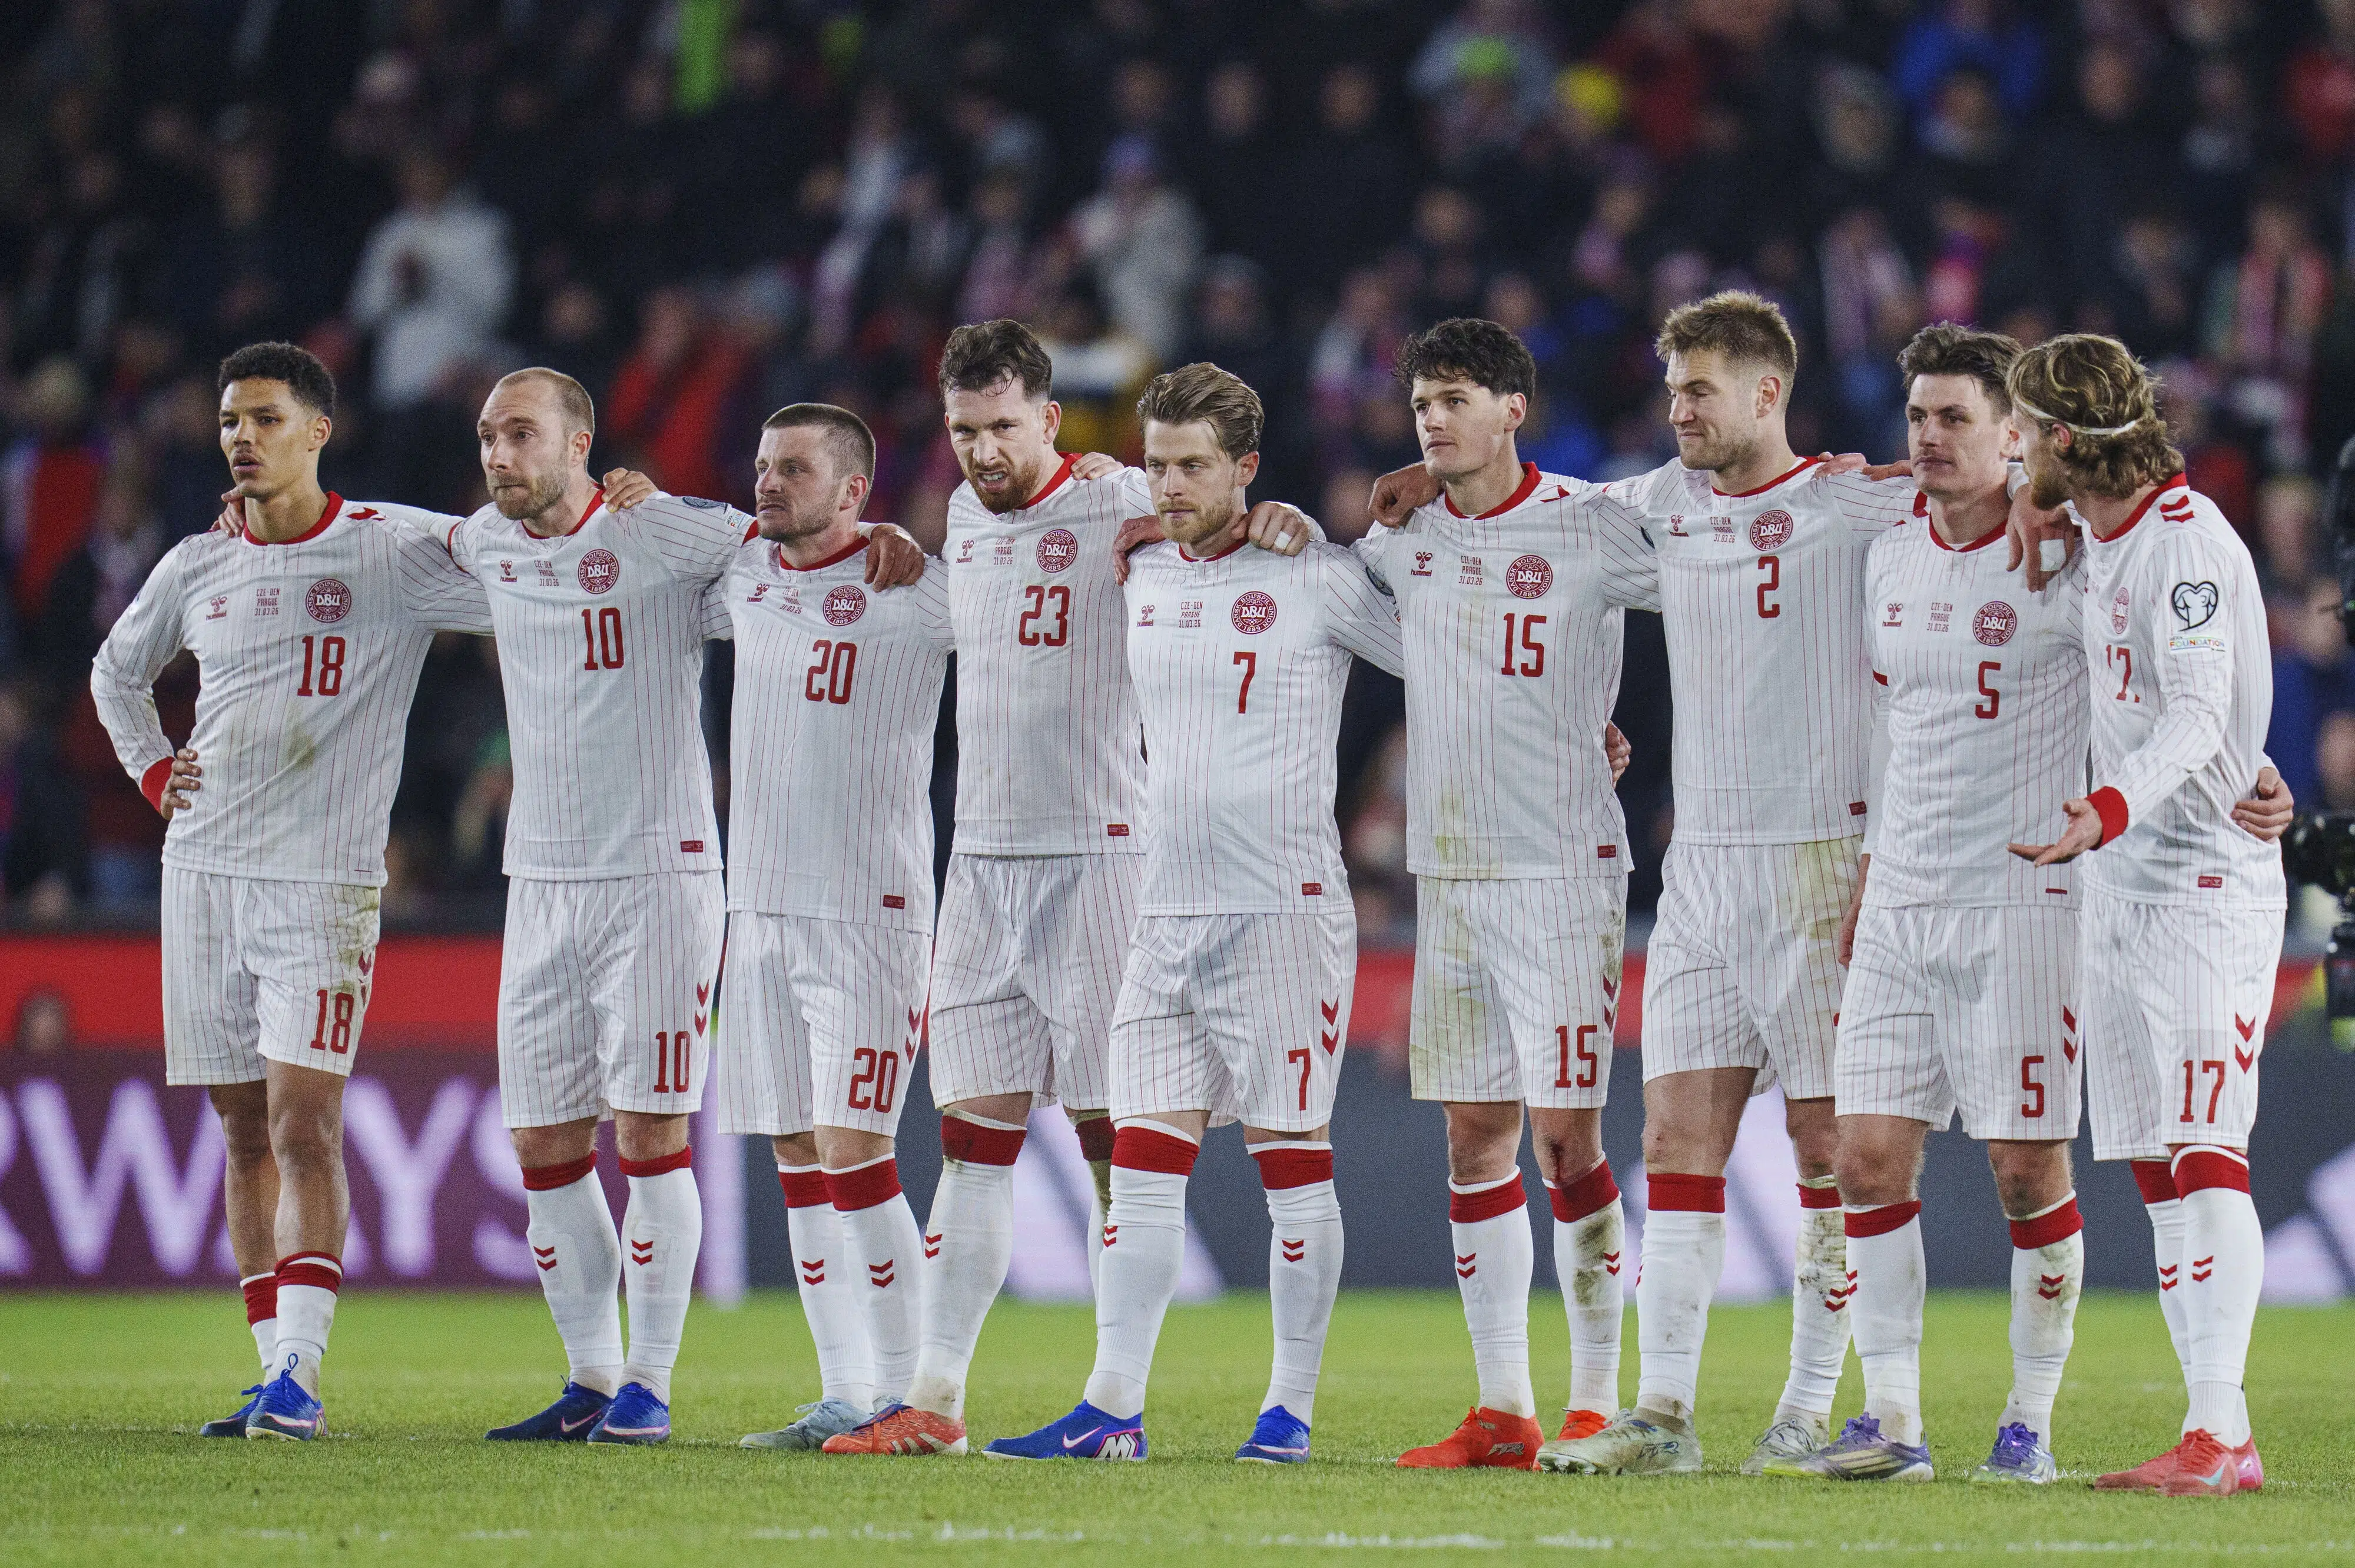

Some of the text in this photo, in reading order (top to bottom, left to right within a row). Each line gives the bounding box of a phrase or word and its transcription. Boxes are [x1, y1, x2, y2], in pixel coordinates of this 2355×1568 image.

[1044, 544, 1068, 556] DBU
[1759, 523, 1783, 536] DBU
[316, 594, 340, 606] DBU
[587, 564, 609, 578] DBU
[1411, 569, 1432, 577] hummel
[1458, 576, 1483, 586] 31.03.26
[1462, 566, 1482, 576] PRAGUE
[1515, 570, 1543, 583] DBU
[1757, 556, 1780, 619] 2
[832, 599, 857, 611] DBU
[1019, 585, 1070, 646] 23
[1178, 619, 1201, 628] 31.03.26
[1240, 606, 1266, 618] DBU
[1982, 616, 2007, 630] DBU
[297, 636, 346, 697] 18
[581, 607, 624, 670] 10
[1501, 613, 1547, 677] 15
[805, 639, 857, 705] 20
[1233, 651, 1256, 714] 7
[1975, 660, 2001, 719] 5
[310, 989, 354, 1055] 18
[654, 1031, 690, 1093] 10
[848, 1047, 898, 1114] 20
[1288, 1048, 1312, 1111] 7
[1555, 1025, 1598, 1088] 15
[2021, 1055, 2045, 1118] 5
[2180, 1059, 2225, 1123] 17
